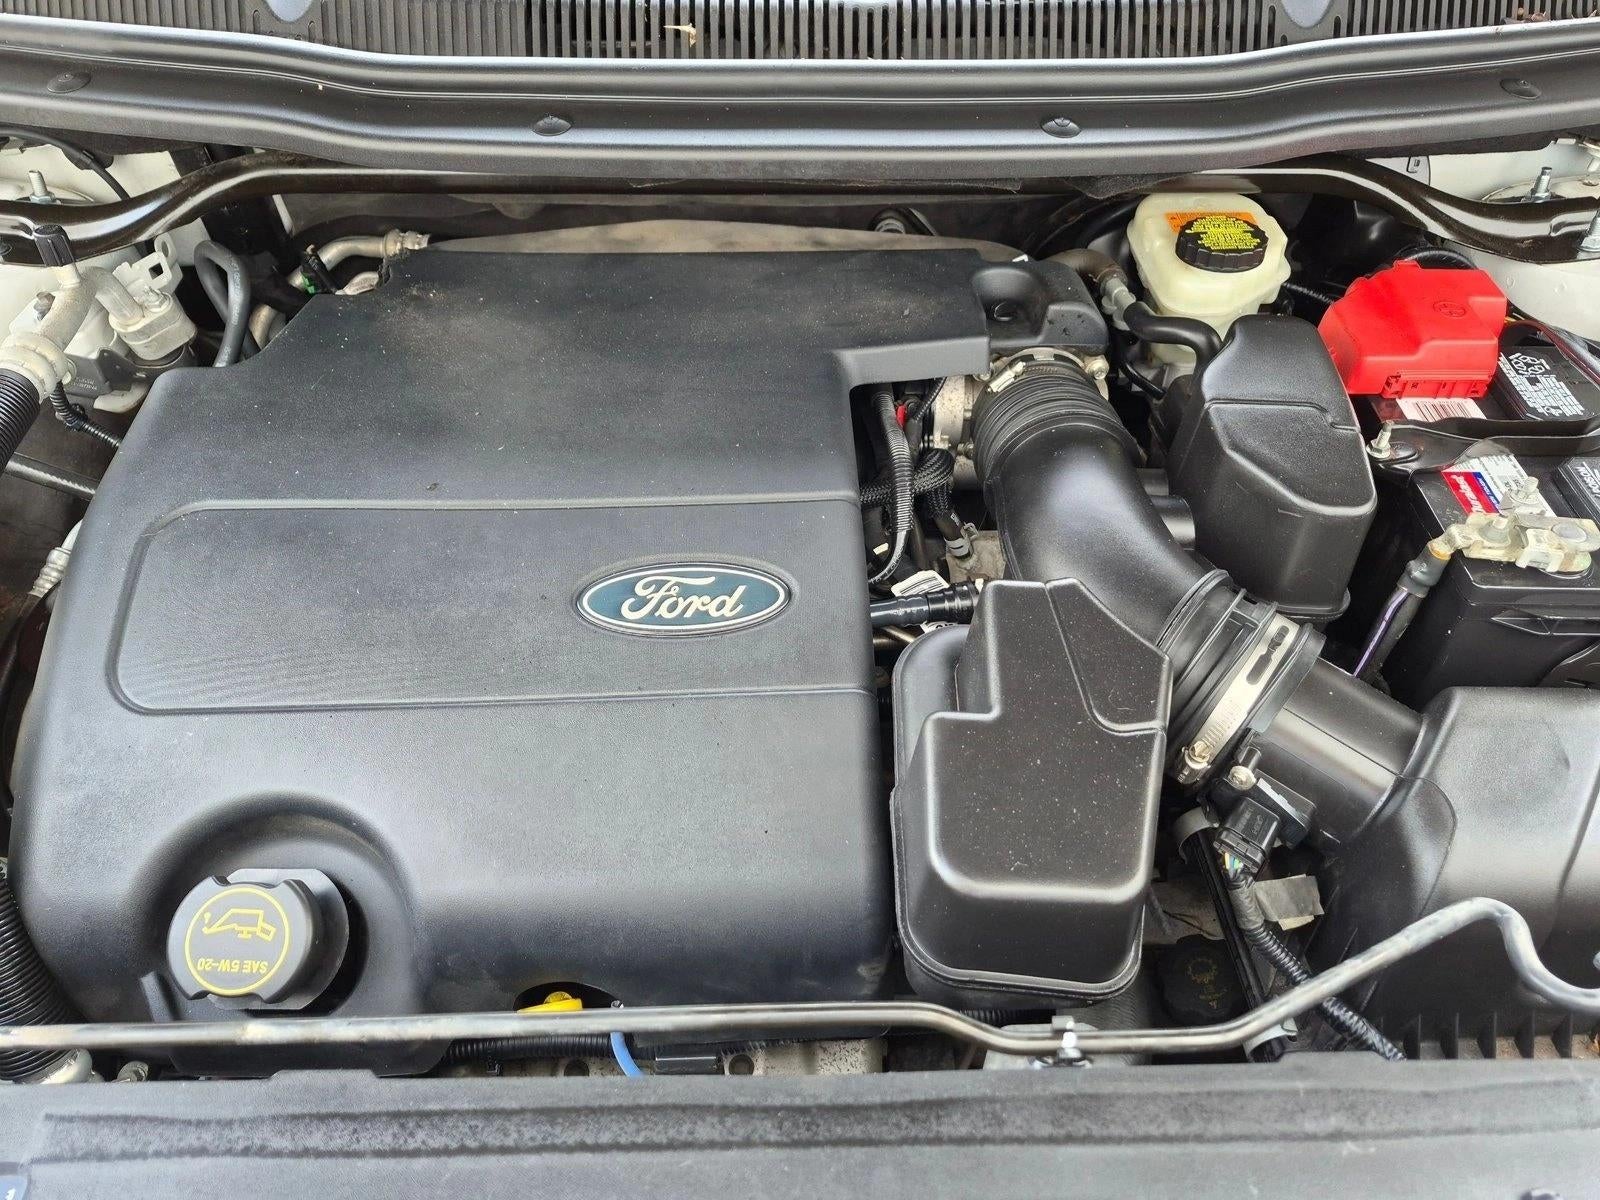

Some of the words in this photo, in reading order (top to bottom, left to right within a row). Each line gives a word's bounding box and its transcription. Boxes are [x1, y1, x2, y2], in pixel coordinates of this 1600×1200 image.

[621, 575, 747, 620] Ford
[197, 957, 240, 972] 5W-20
[242, 959, 269, 974] SAE
